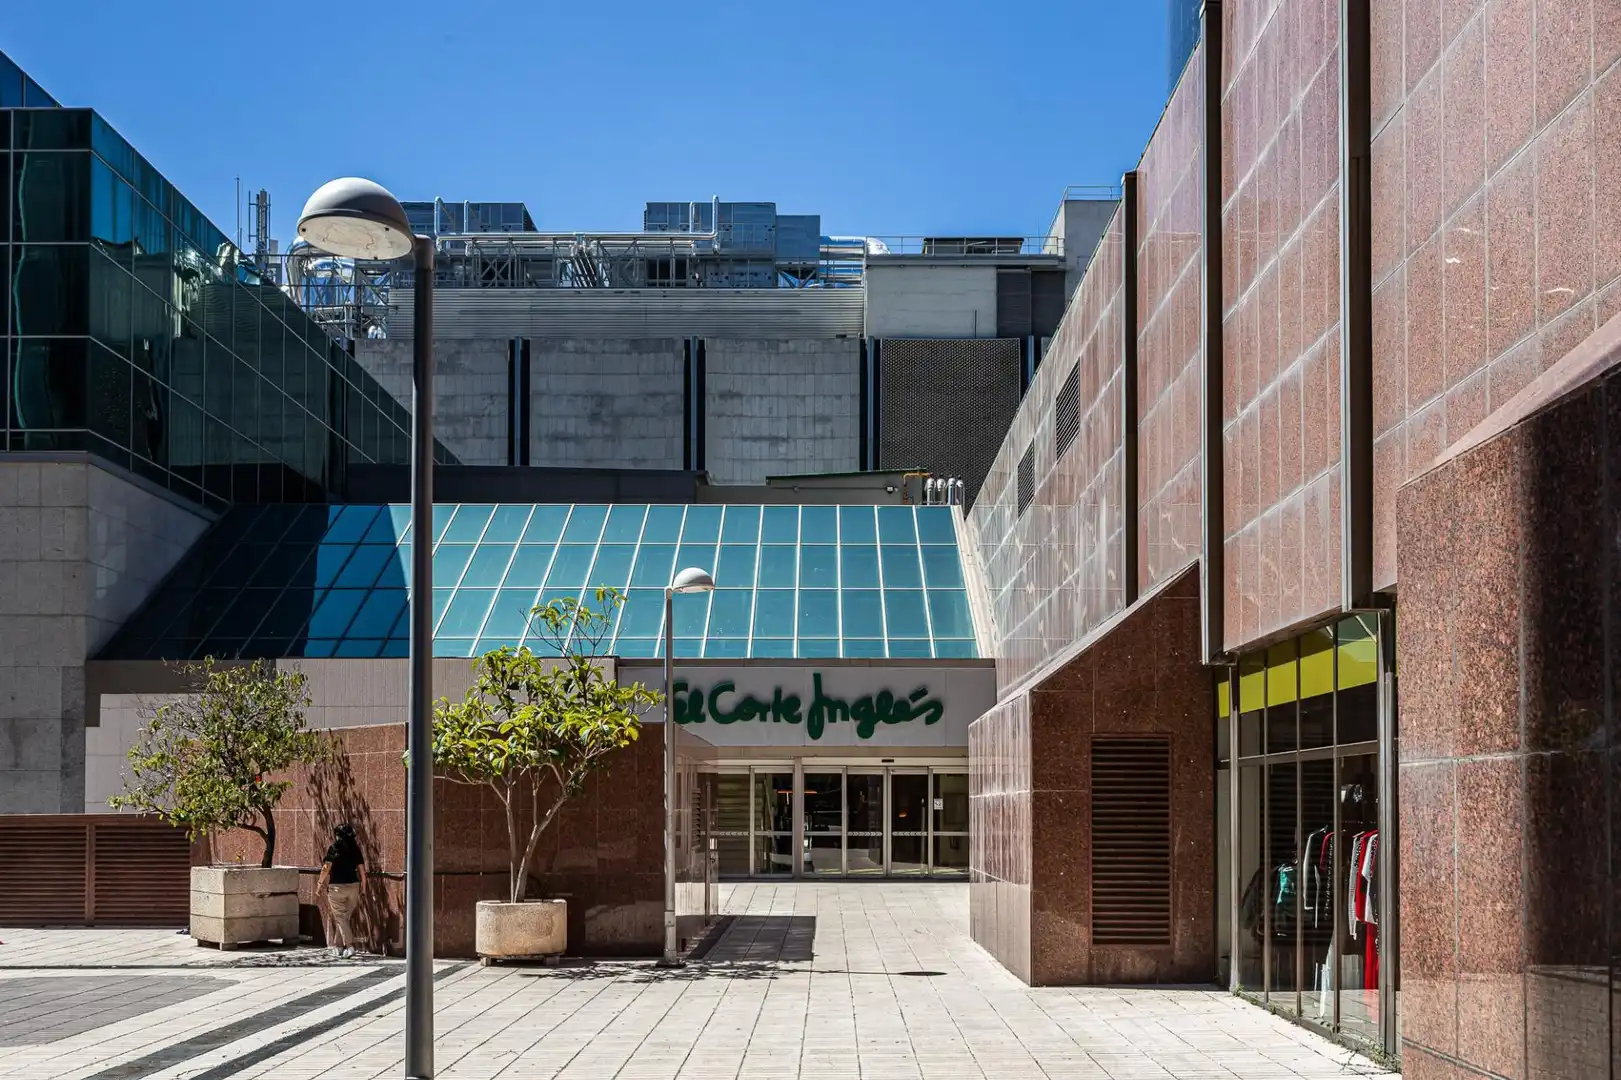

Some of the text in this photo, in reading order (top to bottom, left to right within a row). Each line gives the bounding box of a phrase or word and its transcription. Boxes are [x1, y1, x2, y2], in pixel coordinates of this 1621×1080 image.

[672, 672, 944, 740] El Corte Inglés
